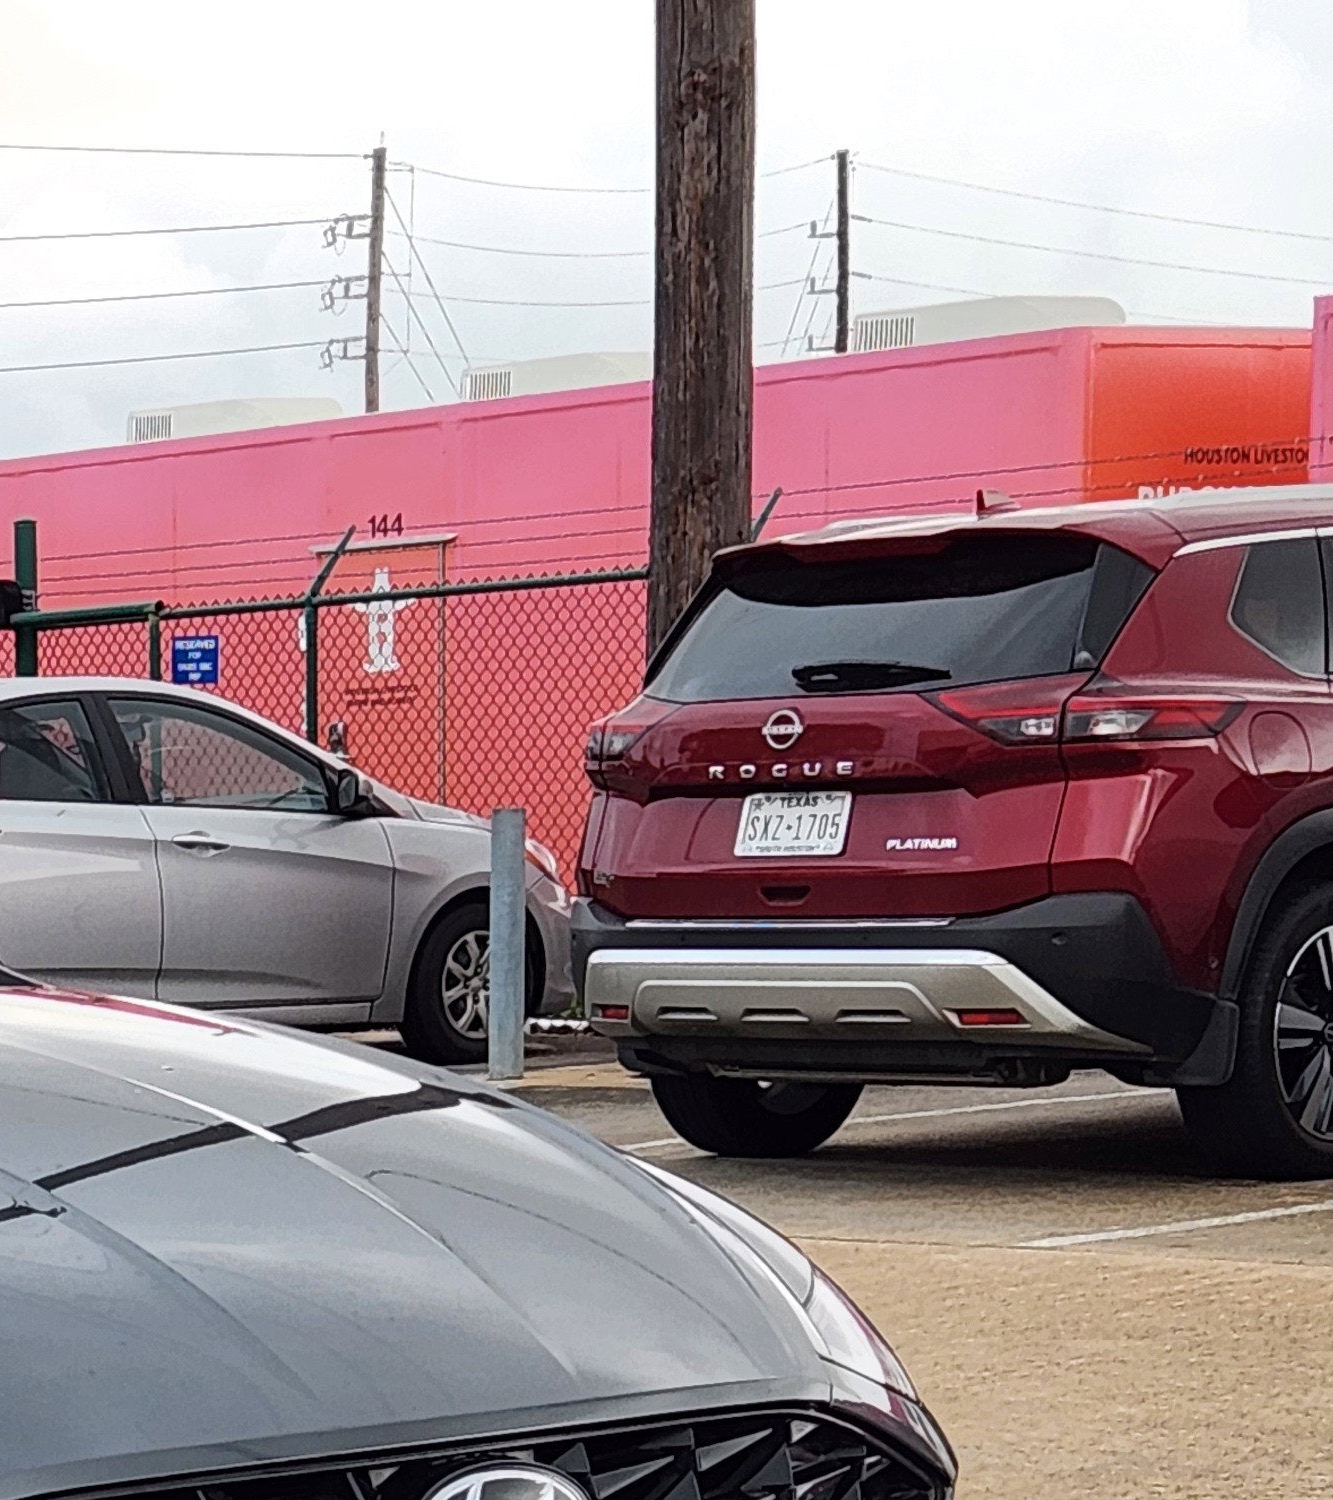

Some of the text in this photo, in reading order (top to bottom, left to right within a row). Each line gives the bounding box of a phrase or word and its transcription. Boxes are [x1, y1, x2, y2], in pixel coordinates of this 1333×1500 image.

[1184, 447, 1250, 465] HOUSTON
[367, 512, 404, 538] 144
[708, 761, 854, 779] ROGUE
[779, 795, 820, 809] TEXAS
[886, 837, 957, 851] PLATINUM
